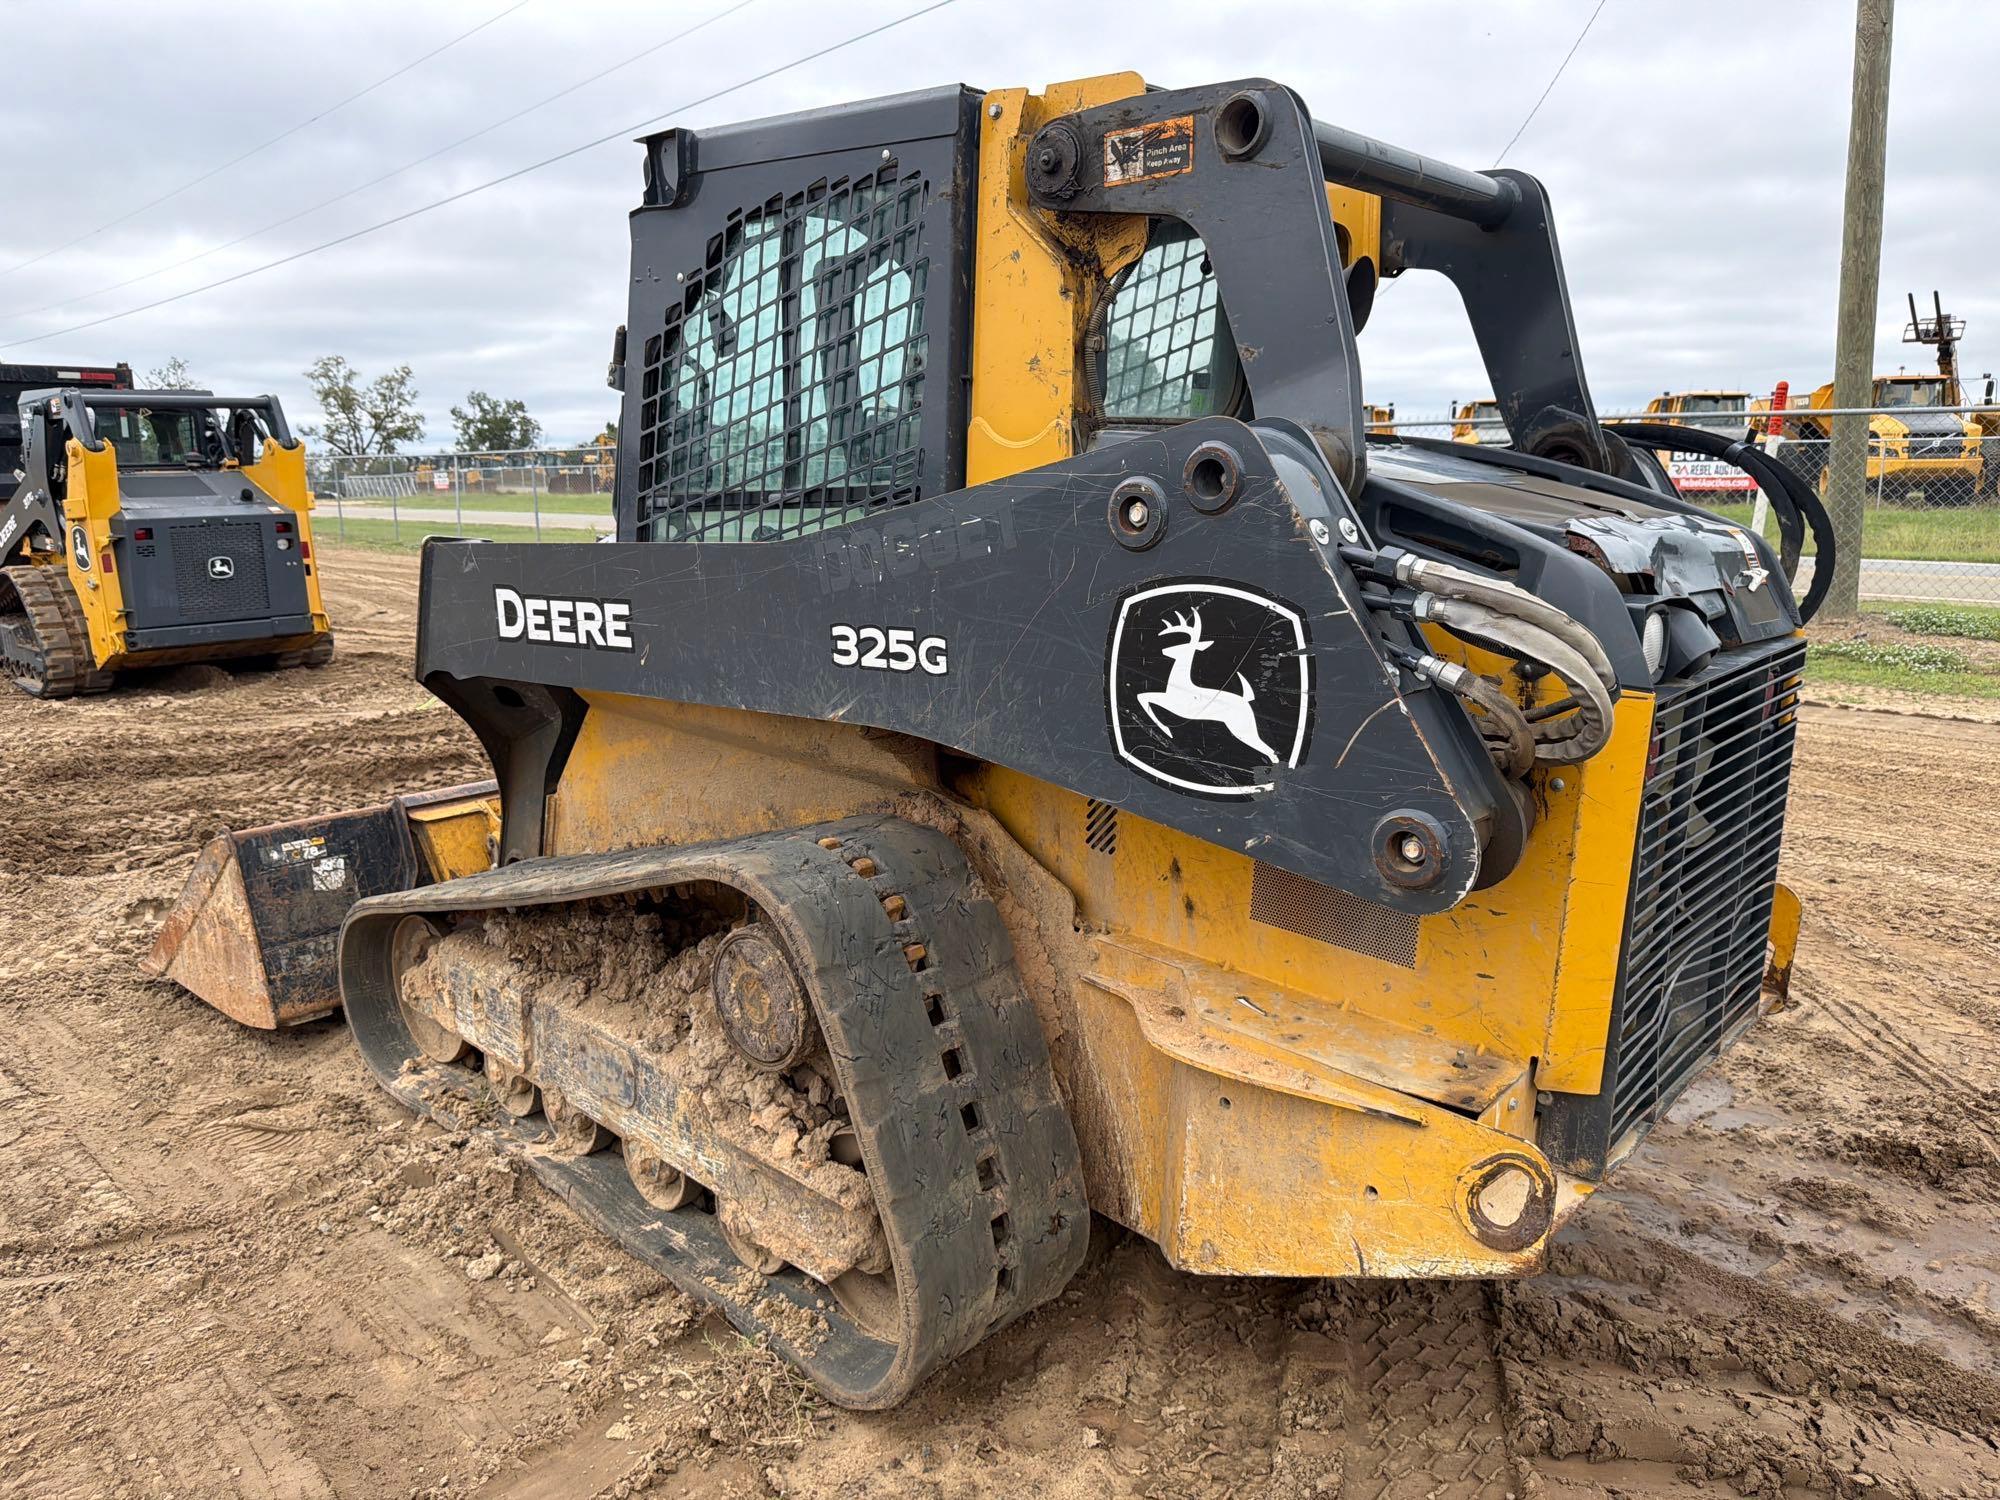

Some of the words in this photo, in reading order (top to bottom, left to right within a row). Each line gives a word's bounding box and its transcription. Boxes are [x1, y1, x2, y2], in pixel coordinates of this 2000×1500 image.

[1146, 146, 1168, 158] Pinch
[1169, 143, 1187, 153] Area
[1146, 159, 1163, 168] Keep
[1164, 156, 1181, 165] Away
[1690, 464, 1711, 475] REBEL
[494, 587, 633, 649] DEERE
[830, 624, 948, 675] 325G
